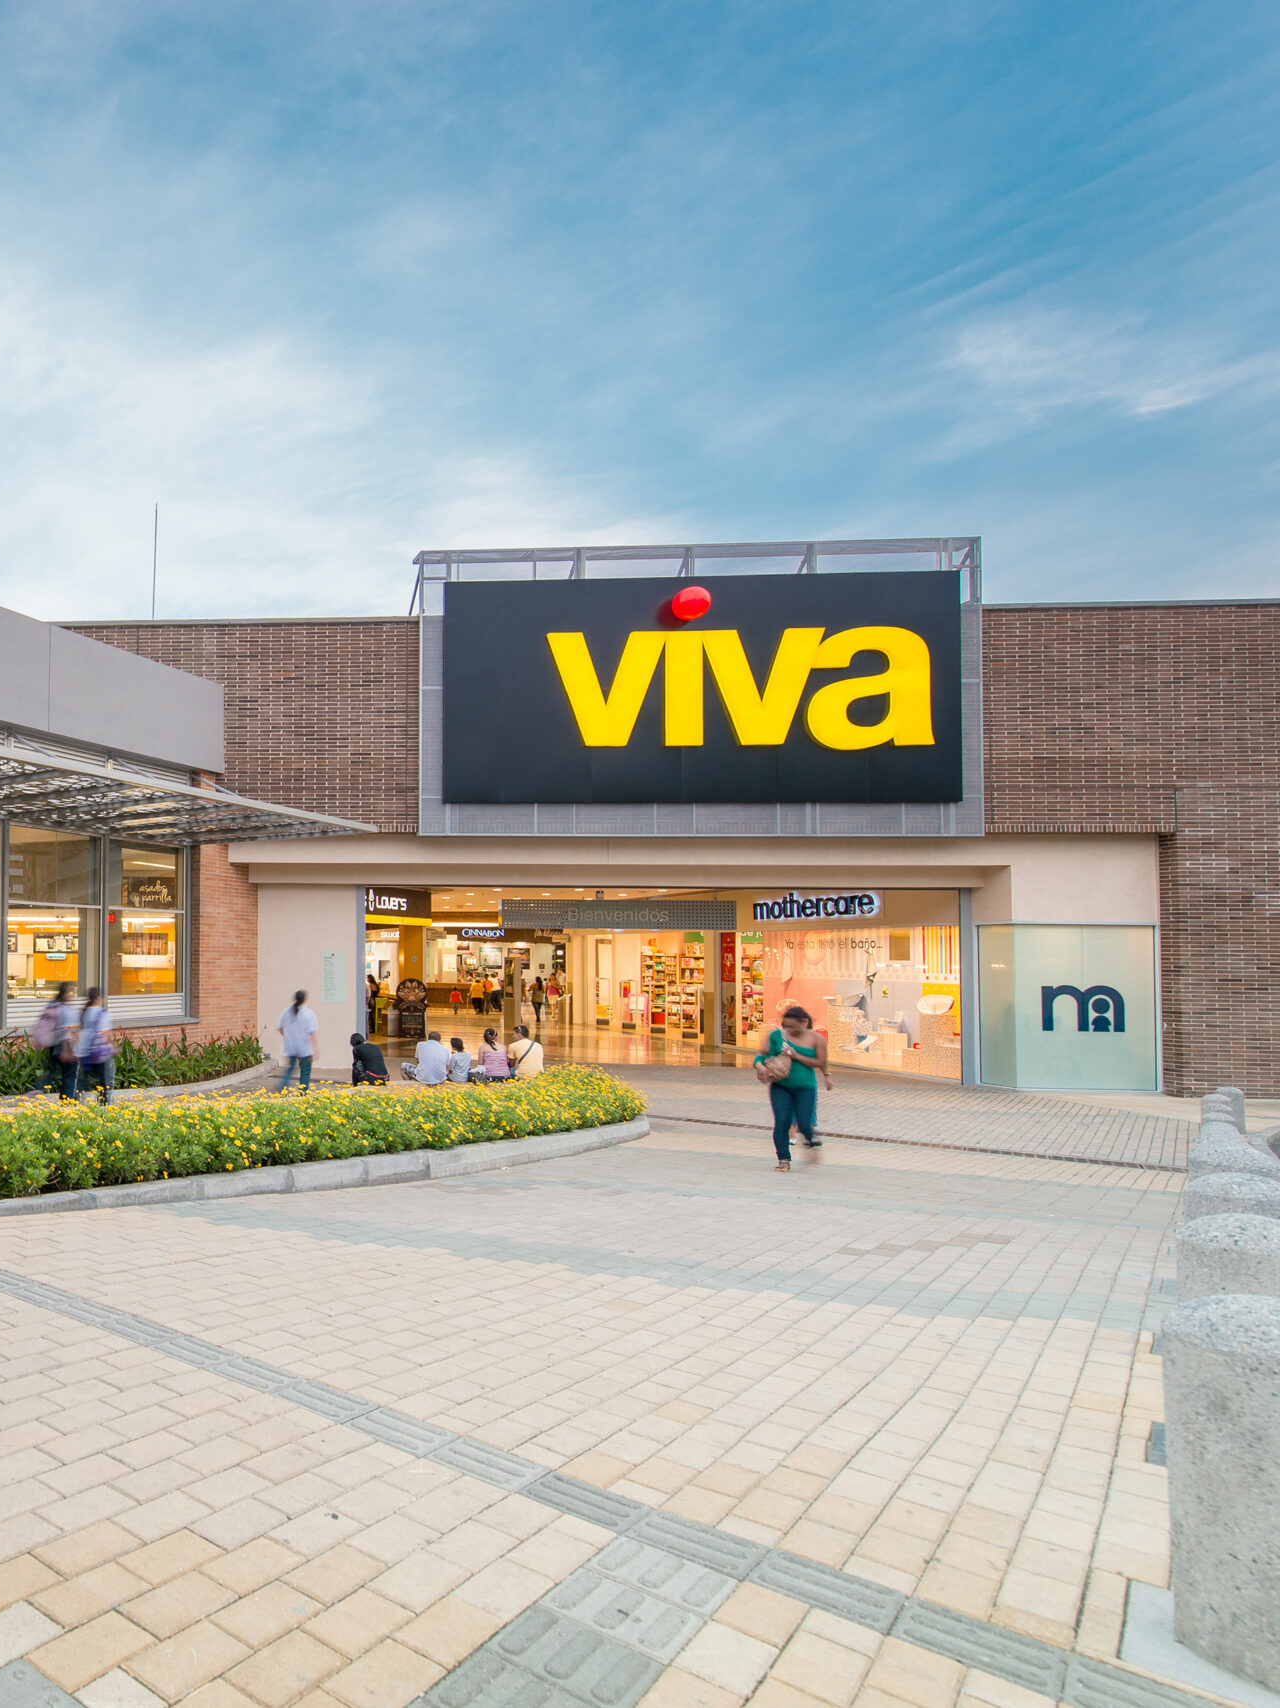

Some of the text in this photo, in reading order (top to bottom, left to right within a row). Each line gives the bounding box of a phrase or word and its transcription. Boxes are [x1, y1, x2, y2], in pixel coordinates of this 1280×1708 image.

[546, 586, 935, 751] viva
[568, 908, 670, 922] Bienvenidos
[753, 892, 875, 920] mothercare
[461, 928, 505, 938] CINNABON
